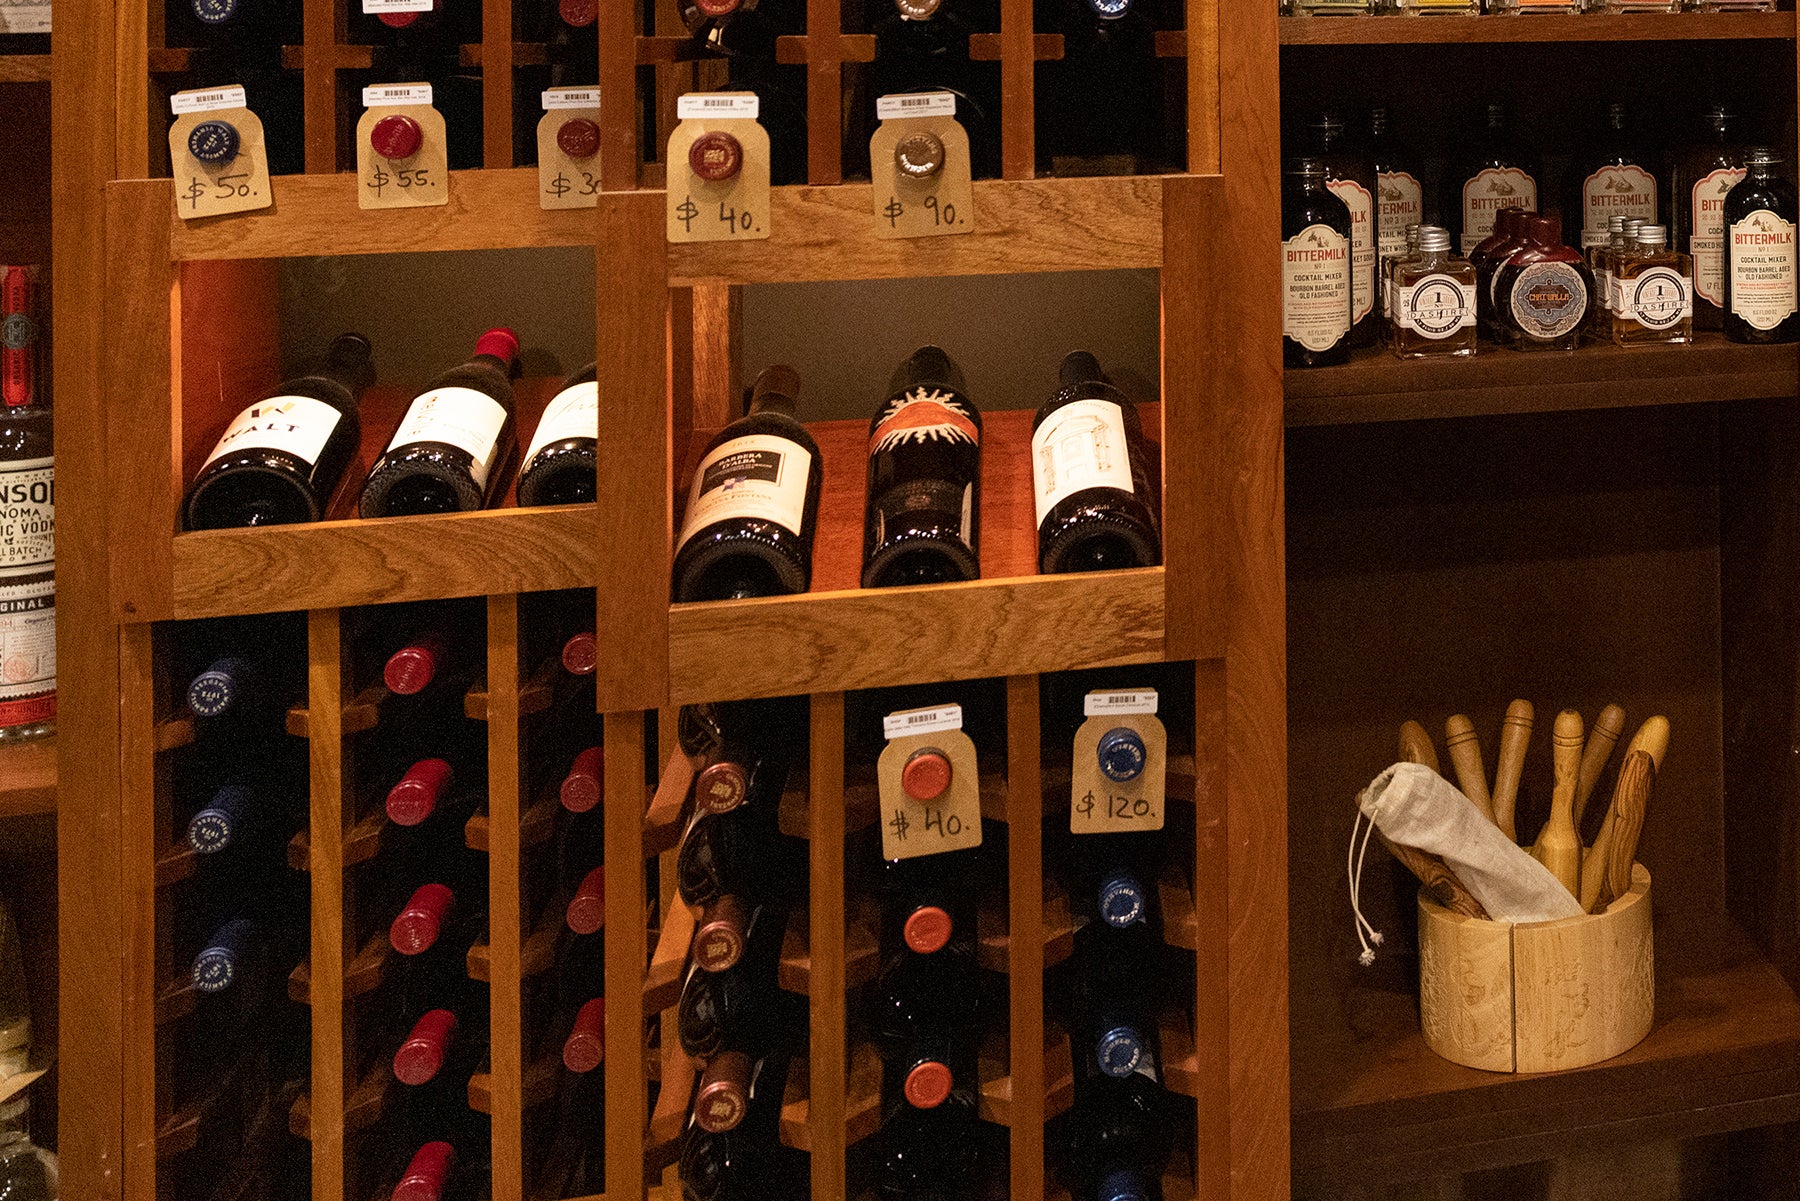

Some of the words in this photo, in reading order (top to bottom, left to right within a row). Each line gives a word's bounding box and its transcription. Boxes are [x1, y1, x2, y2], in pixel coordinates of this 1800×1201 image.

[367, 164, 390, 198] $
[397, 169, 435, 188] 55.
[545, 172, 572, 199] $
[182, 177, 207, 210] $
[215, 173, 257, 199] 50.
[1471, 196, 1531, 211] BITTERMILK
[1591, 193, 1651, 207] BITTERMILK
[676, 195, 699, 232] $
[720, 201, 760, 234] 40.
[882, 196, 904, 228] $
[924, 195, 965, 226] 90.
[1735, 233, 1792, 245] BITTERMILK
[1287, 248, 1347, 262] BITTERMILK
[1768, 255, 1787, 263] MIXER
[1293, 273, 1324, 282] COCKTAIL
[1325, 272, 1342, 281] MIXER
[1759, 266, 1778, 274] BARREL
[1289, 284, 1314, 293] BOURBON
[1315, 283, 1334, 292] BARREL
[1656, 286, 1663, 296] 1
[1299, 292, 1310, 300] OLD
[1311, 291, 1339, 299] FASHIONED
[1435, 292, 1442, 302] 1
[1410, 307, 1464, 320] DASHFIRE
[1633, 301, 1684, 312] DASHFIRE
[718, 452, 763, 467] BARBERA
[0, 481, 54, 505] NSO
[1076, 790, 1095, 820] $
[1108, 794, 1156, 819] 120.
[889, 809, 910, 841] $
[925, 806, 970, 838] 40.
